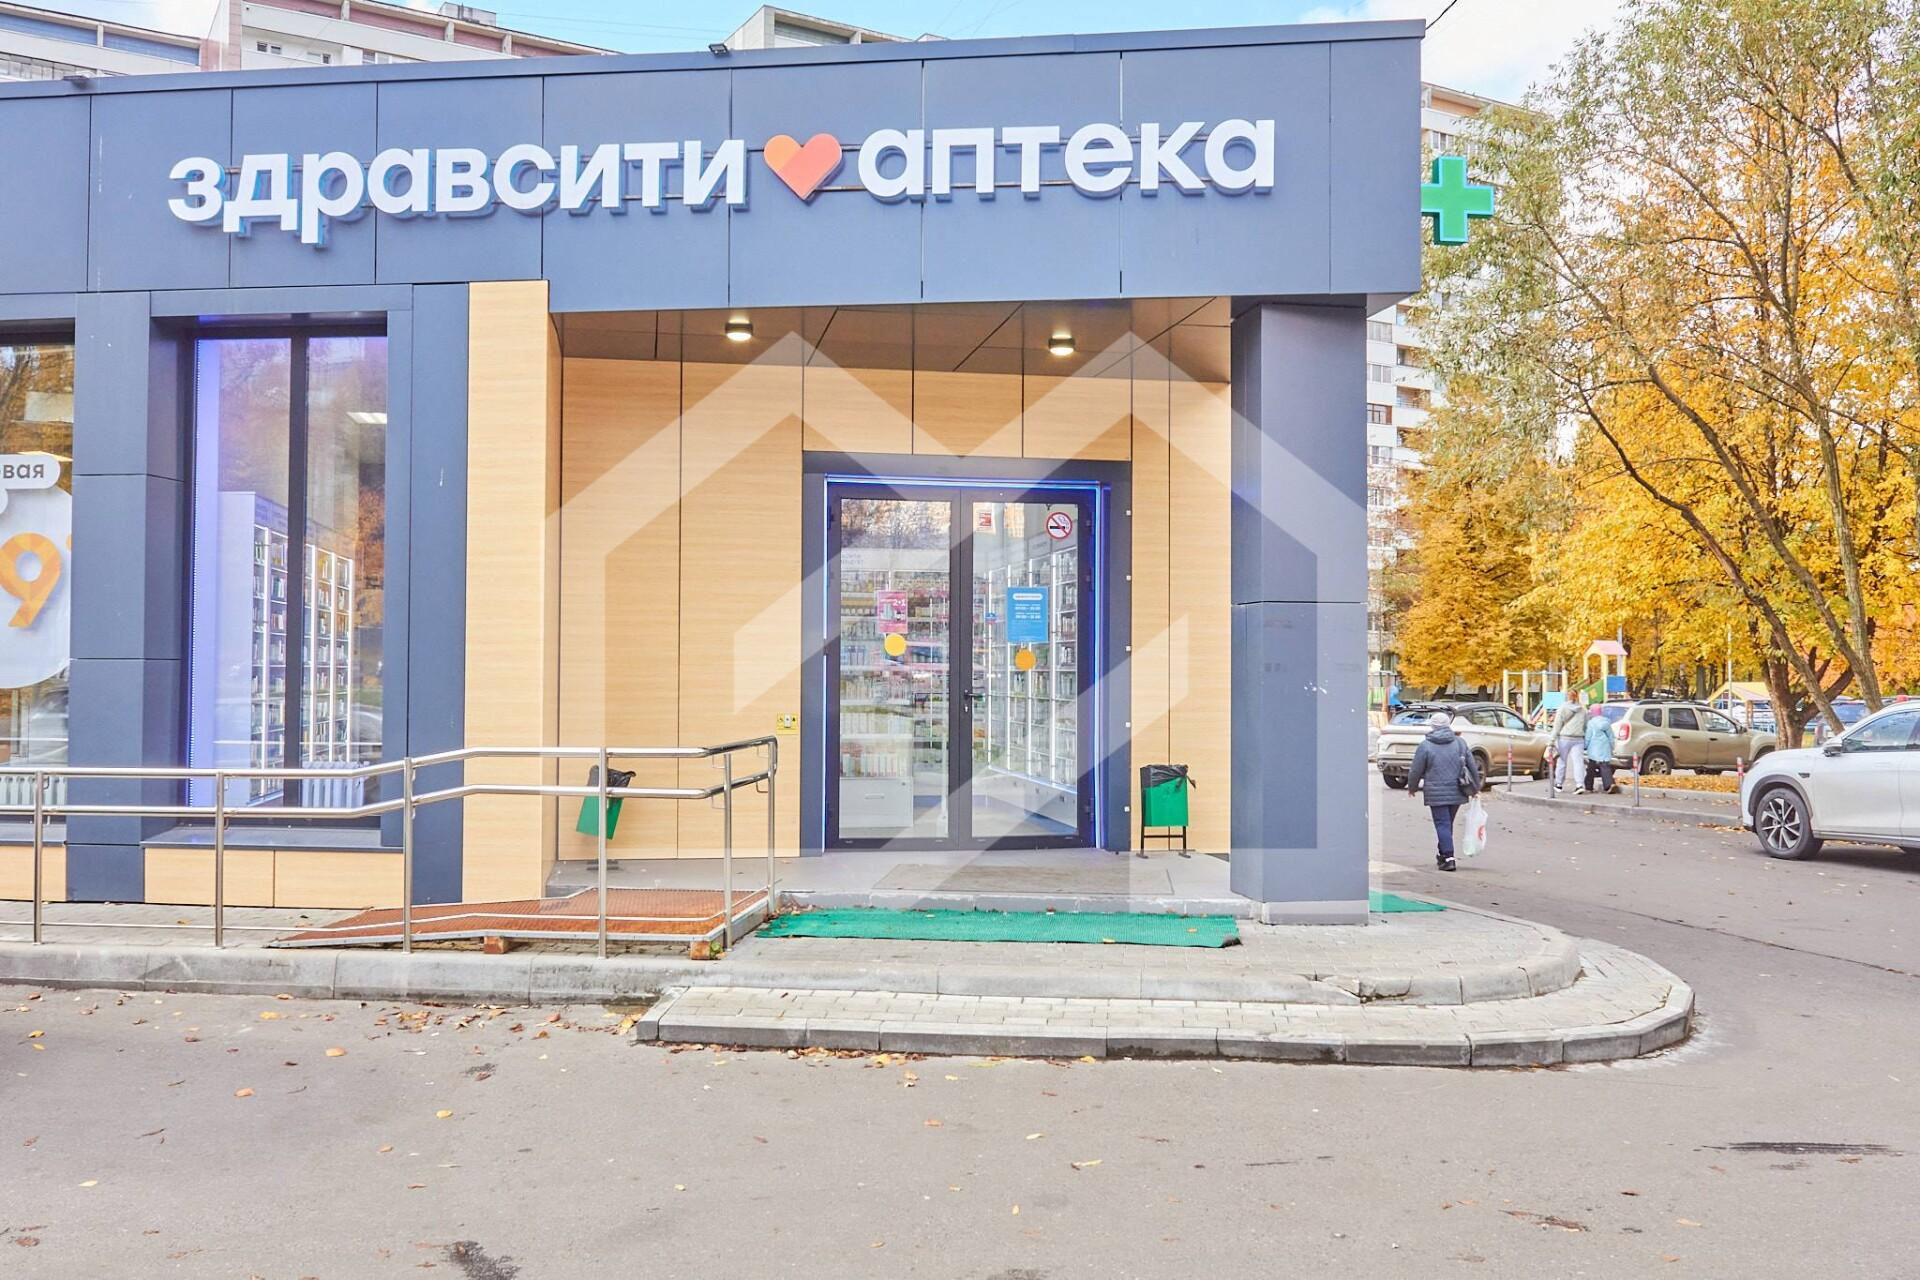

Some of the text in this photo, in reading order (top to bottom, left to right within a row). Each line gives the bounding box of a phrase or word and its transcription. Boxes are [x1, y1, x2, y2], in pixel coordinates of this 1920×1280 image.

[167, 118, 1276, 247] здравсити аптека
[0, 463, 44, 479] вая
